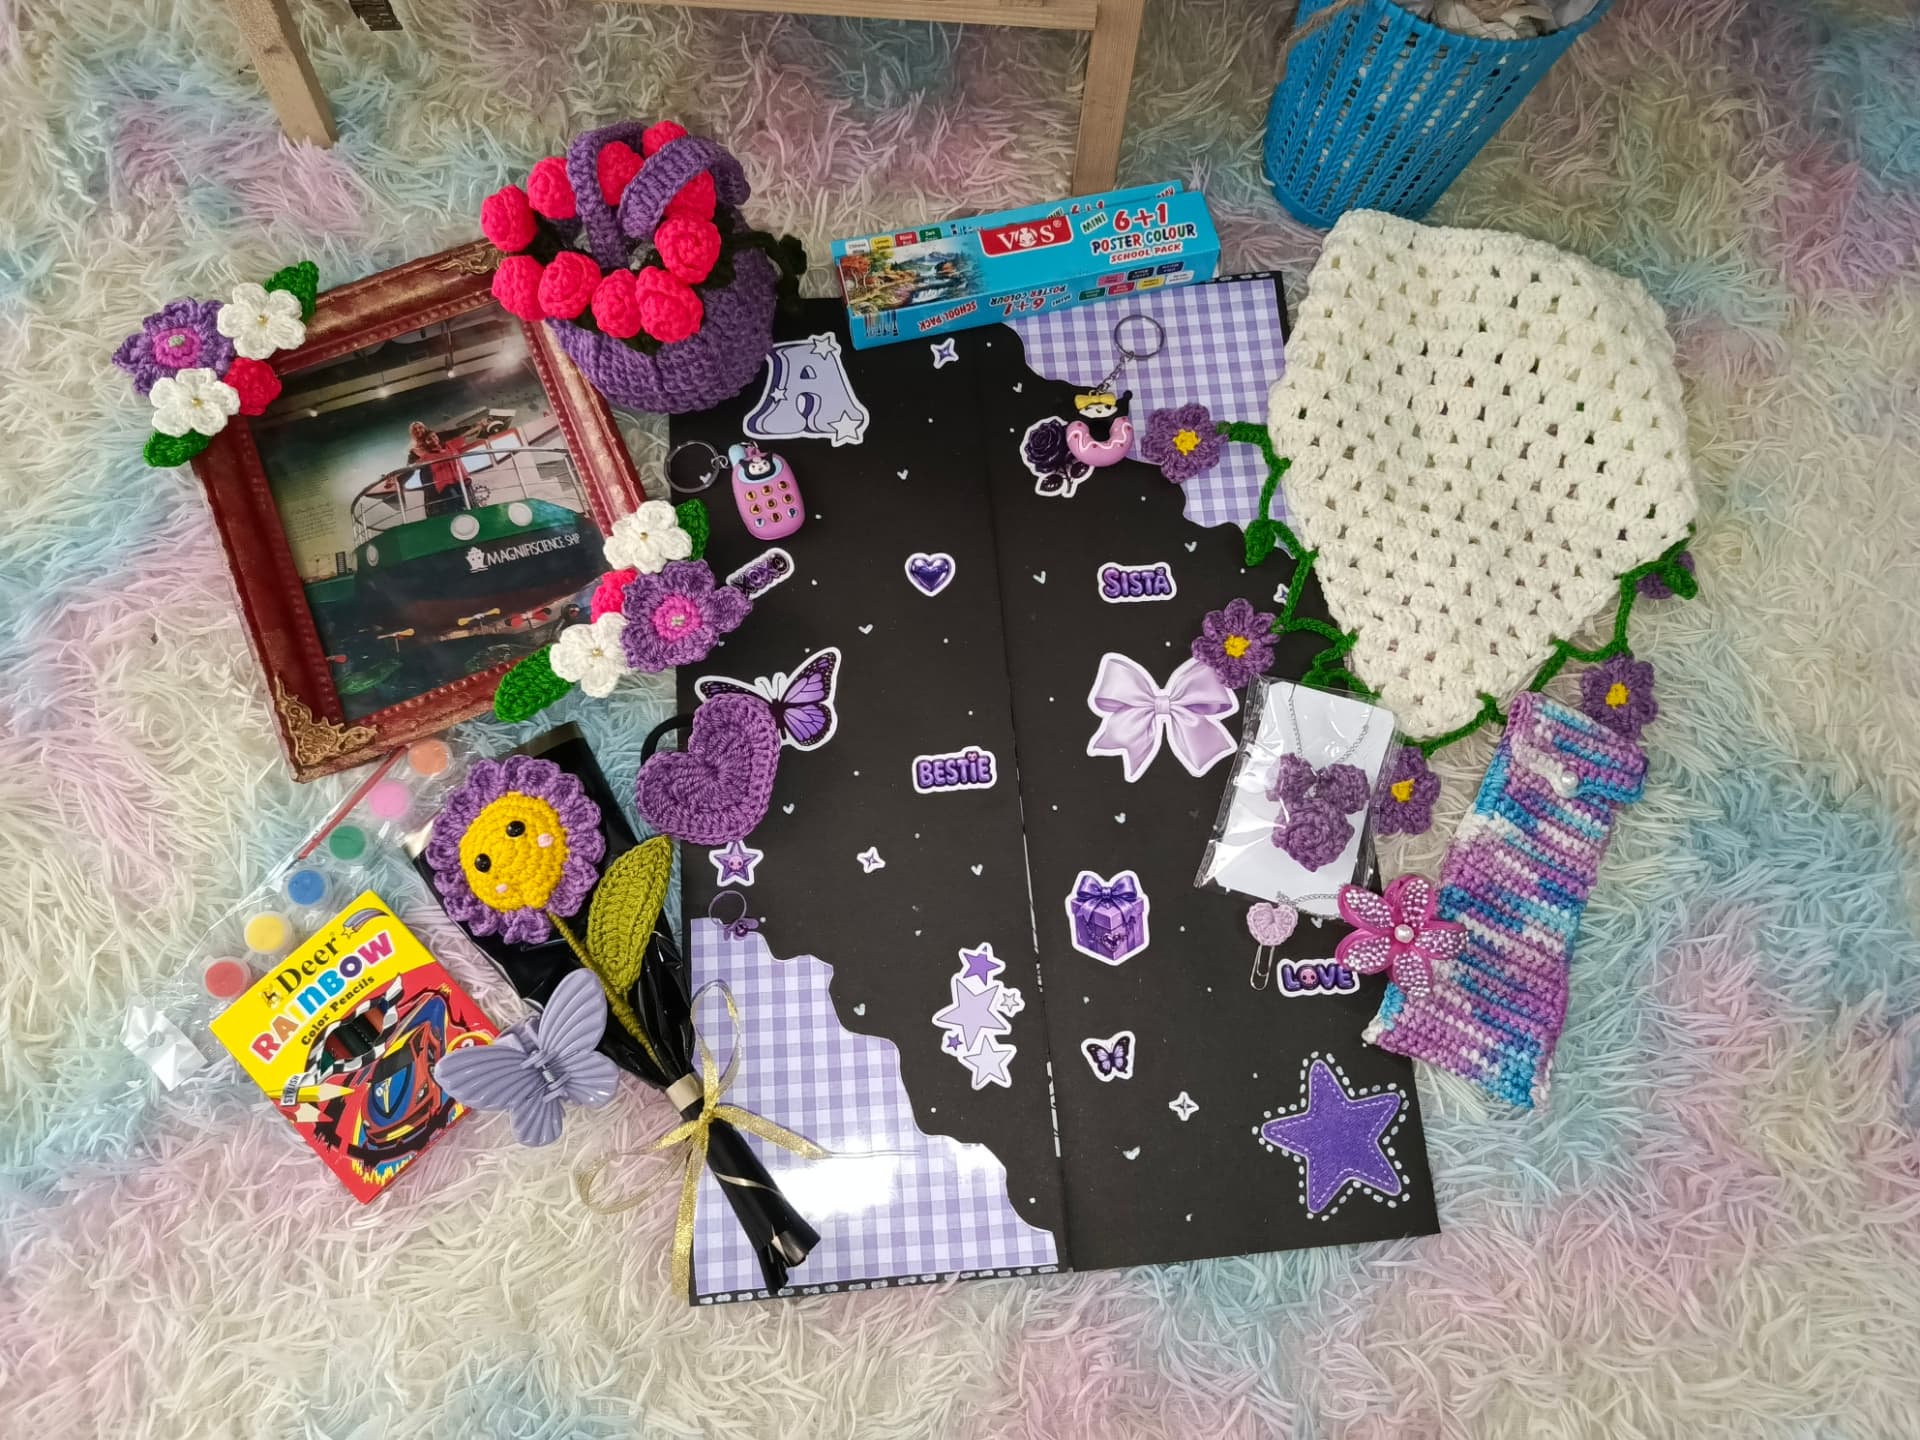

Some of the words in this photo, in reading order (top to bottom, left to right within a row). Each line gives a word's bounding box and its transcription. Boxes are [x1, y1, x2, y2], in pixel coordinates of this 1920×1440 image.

[1082, 213, 1107, 233] MINI
[1113, 203, 1168, 231] 6+1
[1092, 235, 1142, 253] POSTER
[1145, 224, 1196, 243] COLOUR
[1111, 248, 1153, 263] SCHOOL
[1154, 243, 1182, 255] PACK
[918, 315, 943, 331] PACK
[944, 301, 977, 321] SCHOOL
[564, 532, 580, 547] SHIP
[276, 936, 339, 995] Deer
[1281, 963, 1355, 992] LOVE
[301, 1012, 330, 1046] Color
[329, 975, 376, 1013] Pencils
